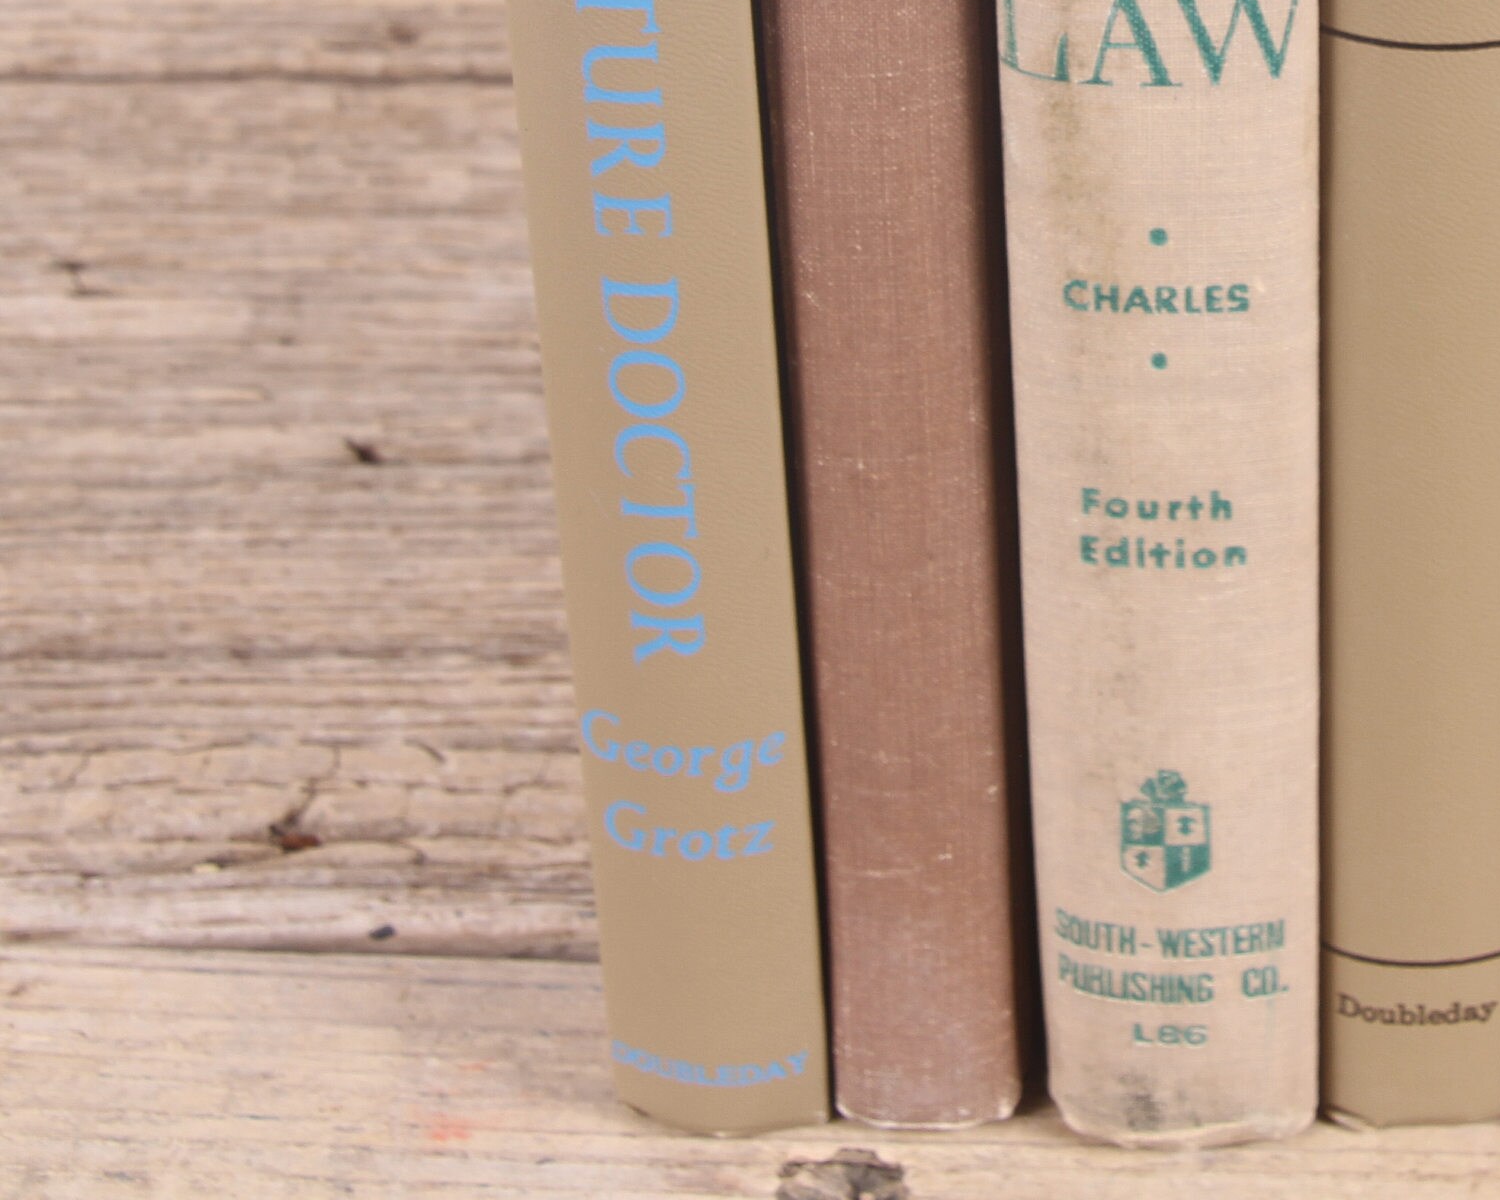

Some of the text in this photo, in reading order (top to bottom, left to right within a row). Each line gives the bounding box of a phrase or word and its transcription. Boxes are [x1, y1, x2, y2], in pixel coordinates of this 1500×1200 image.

[1062, 279, 1251, 314] CHARLES
[601, 276, 706, 666] DOCTOR
[1080, 487, 1234, 521] Fourth
[1079, 535, 1248, 569] Edition
[580, 708, 788, 792] George
[604, 799, 777, 862] Grotz
[1053, 906, 1285, 960] SOUTH-WESTERN
[1056, 952, 1290, 1005] PUBLISHING CO.
[1337, 992, 1499, 1027] Doubleday
[612, 1040, 810, 1088] DOUBLEDAY
